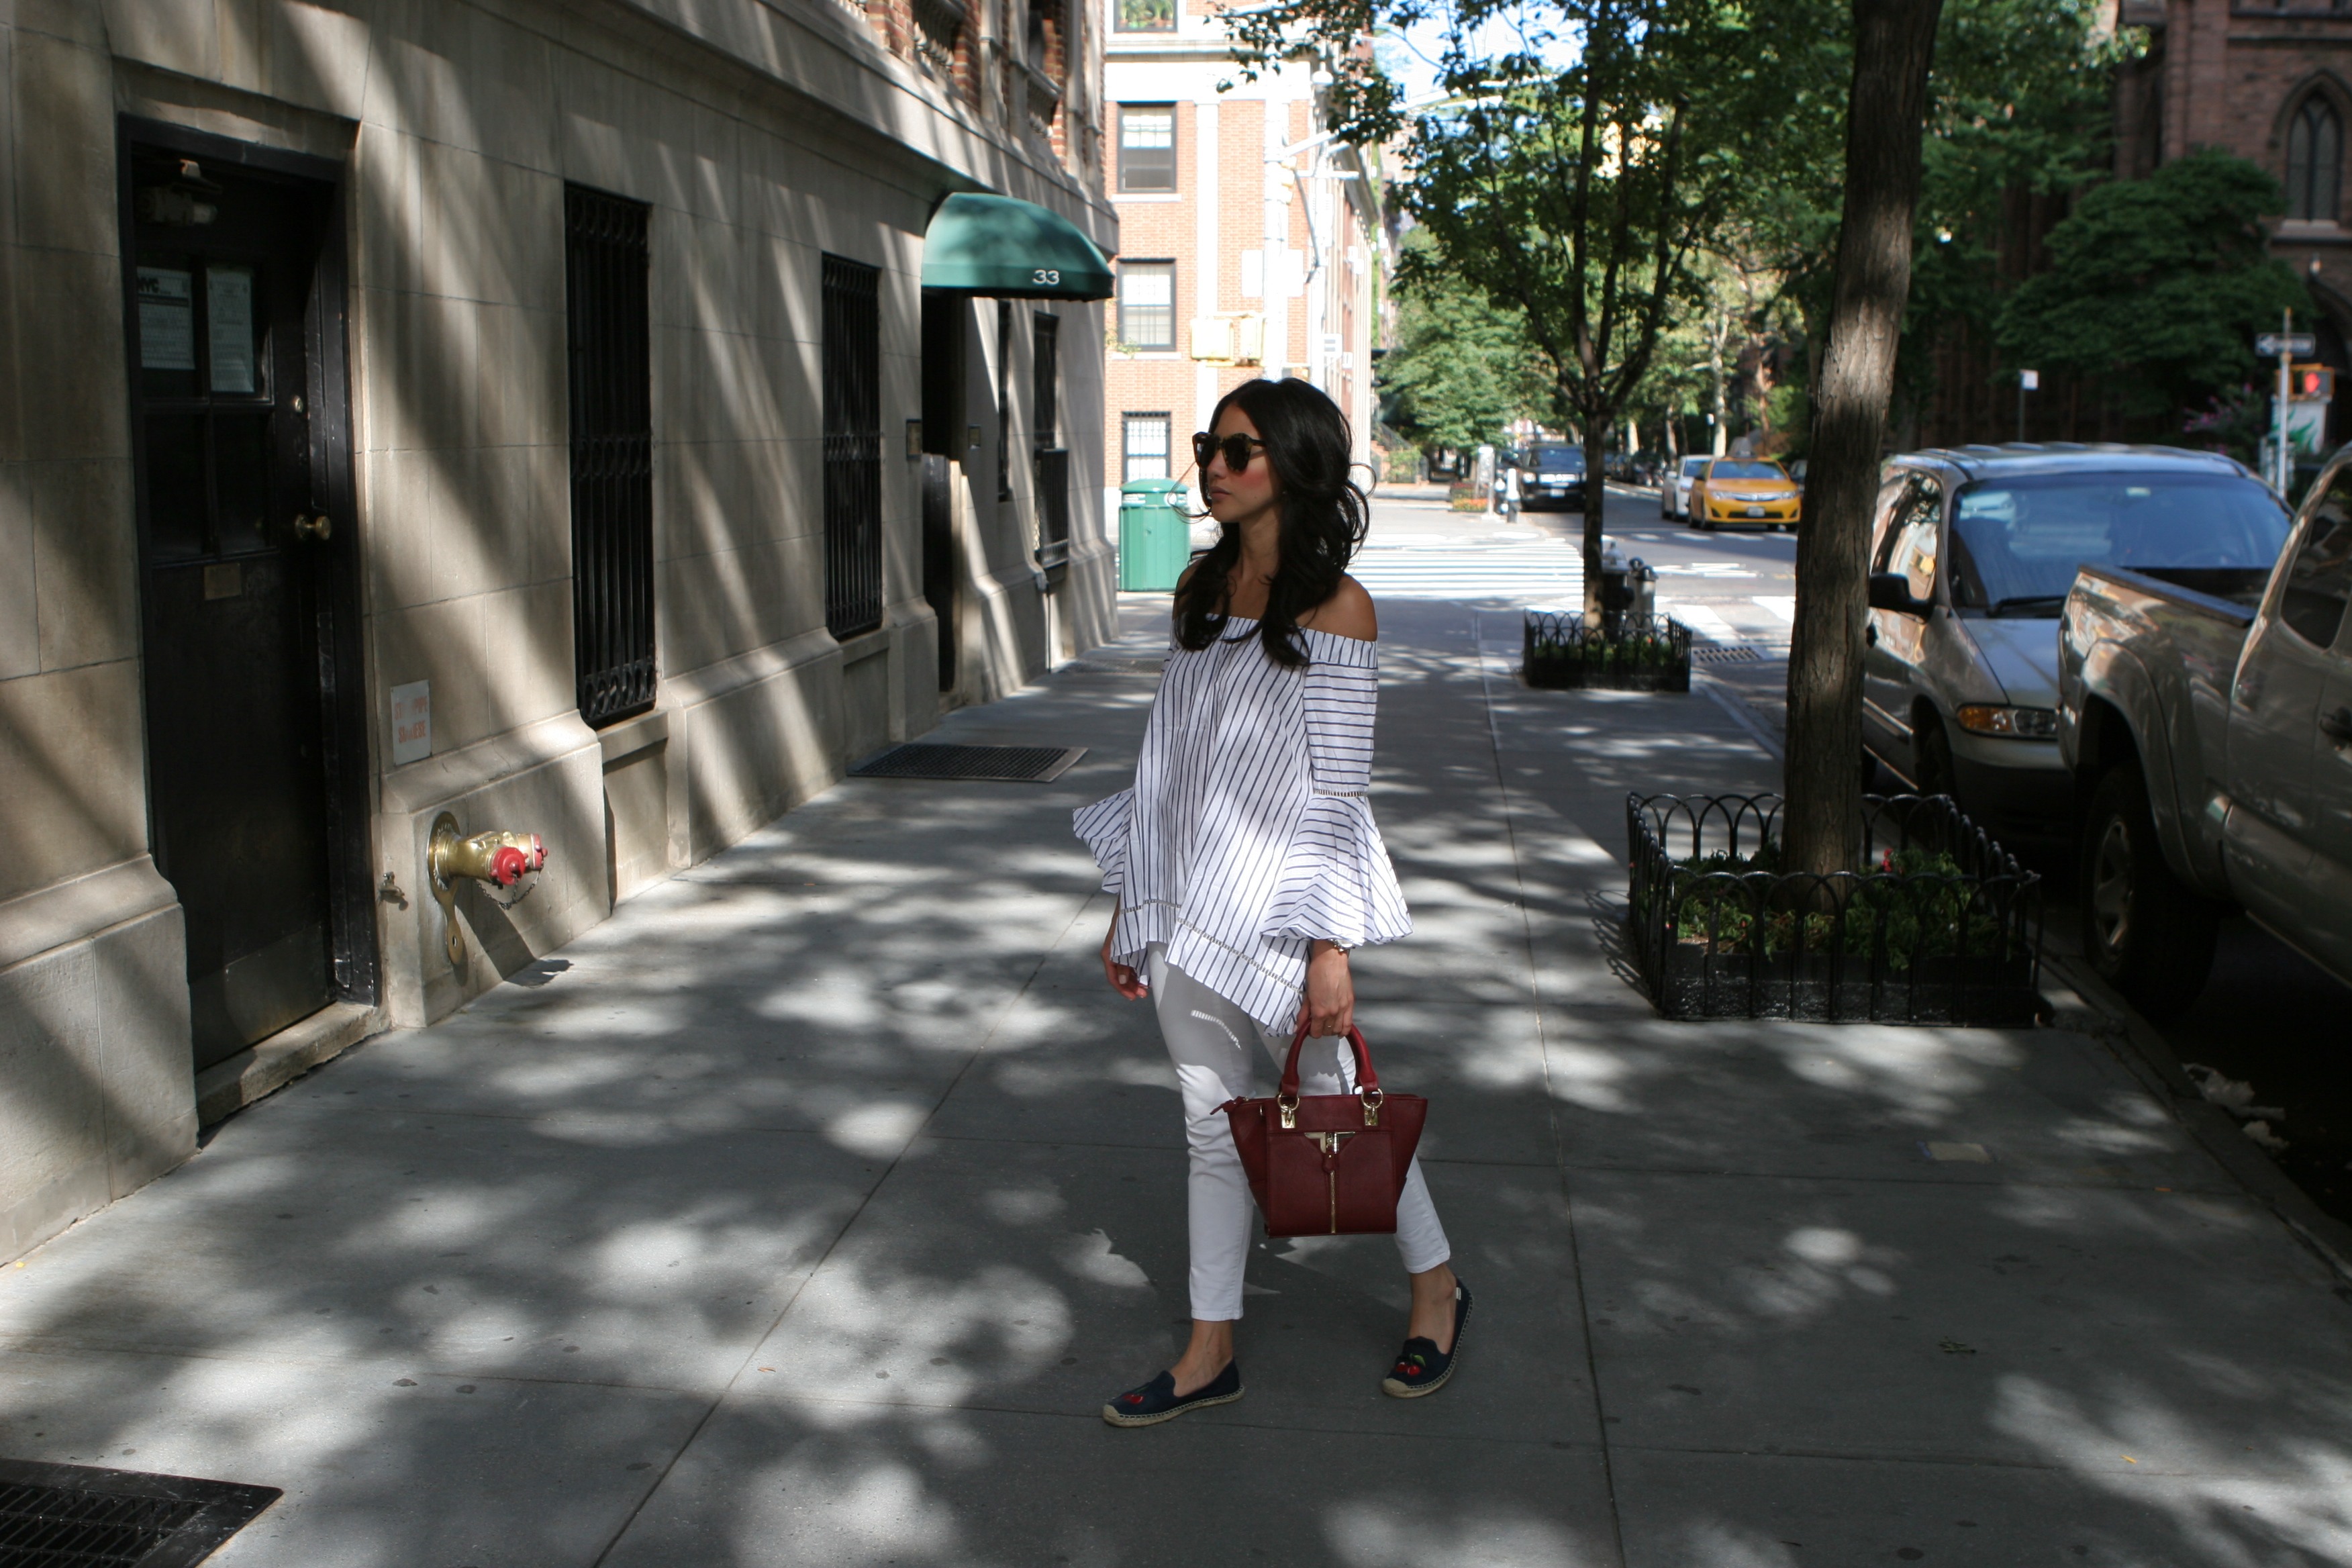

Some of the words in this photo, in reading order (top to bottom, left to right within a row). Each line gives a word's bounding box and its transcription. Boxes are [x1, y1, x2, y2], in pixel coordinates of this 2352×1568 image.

[1033, 269, 1059, 285] 33
[395, 697, 428, 720] STPIPE
[399, 720, 426, 743] SIESE
